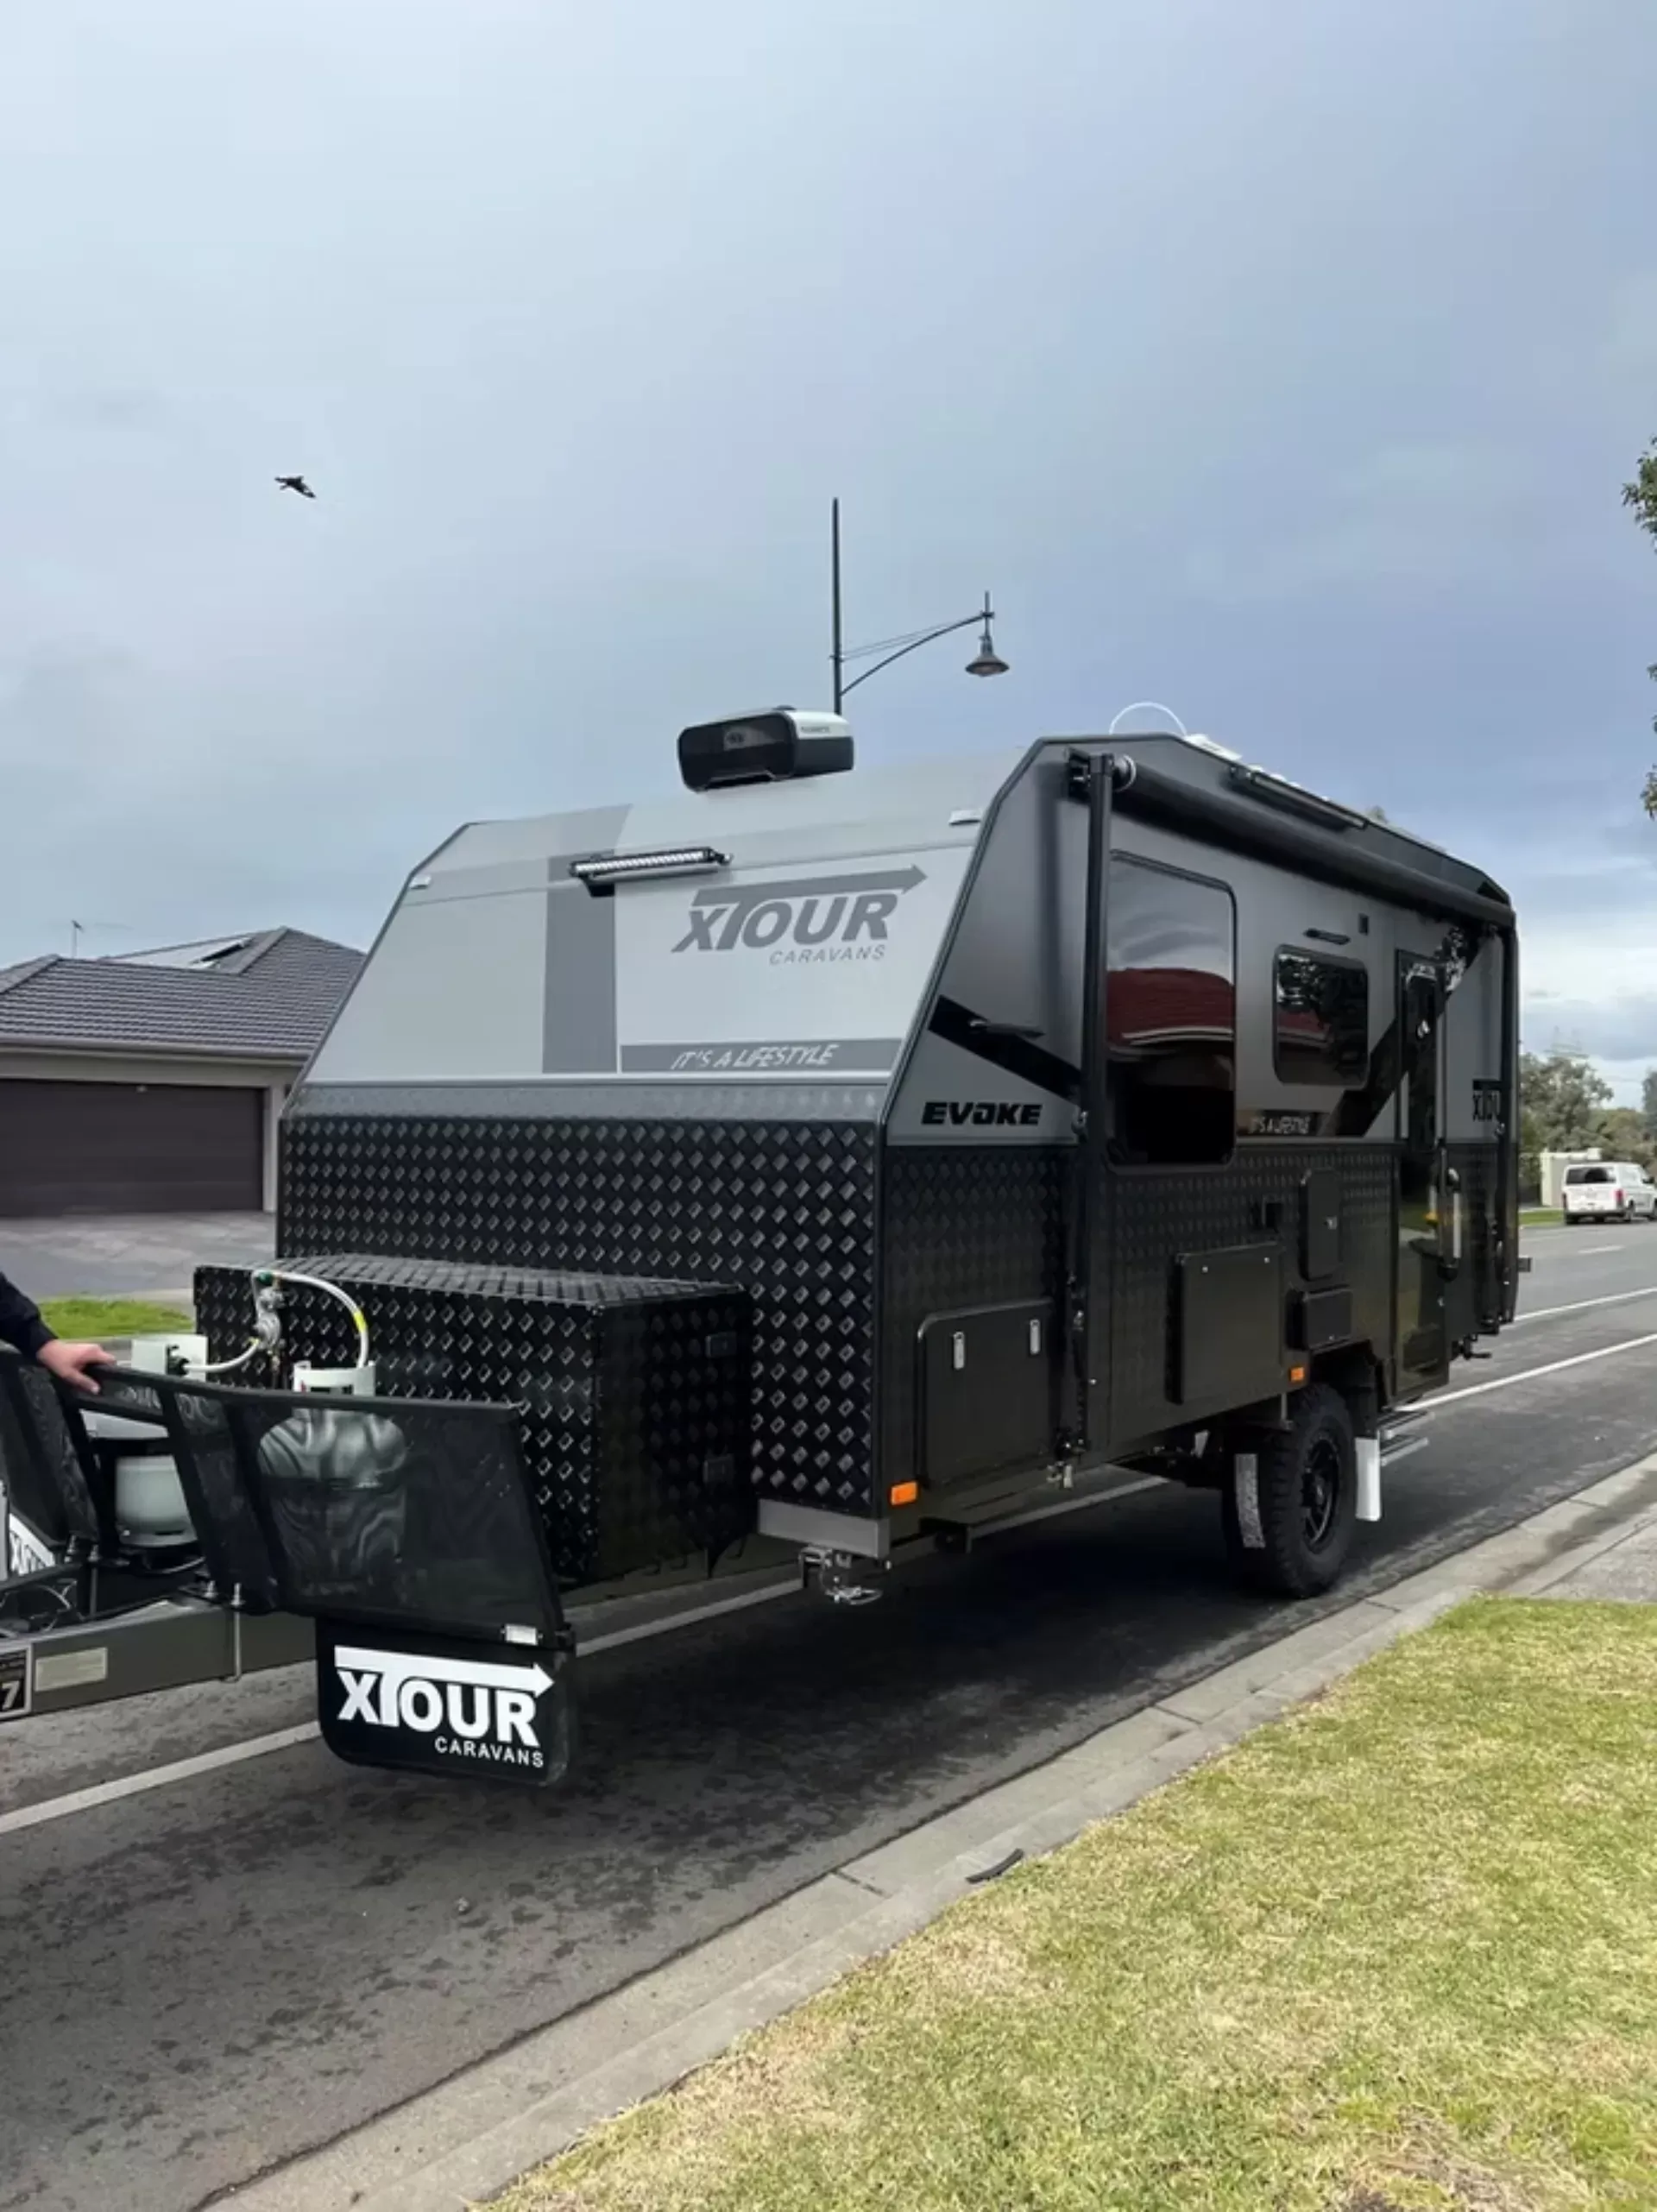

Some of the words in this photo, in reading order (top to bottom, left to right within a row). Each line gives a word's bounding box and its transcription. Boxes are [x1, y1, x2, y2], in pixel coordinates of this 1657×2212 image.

[671, 870, 910, 952] XTOUR
[769, 944, 885, 965] CARAVANS
[670, 1049, 714, 1069] IT'S
[713, 1049, 732, 1068] A
[733, 1043, 841, 1067] LIFESTYLE
[921, 1101, 1043, 1126] EVOKE
[335, 1647, 547, 1747] XTOUR
[434, 1736, 544, 1768] CARAVANS
